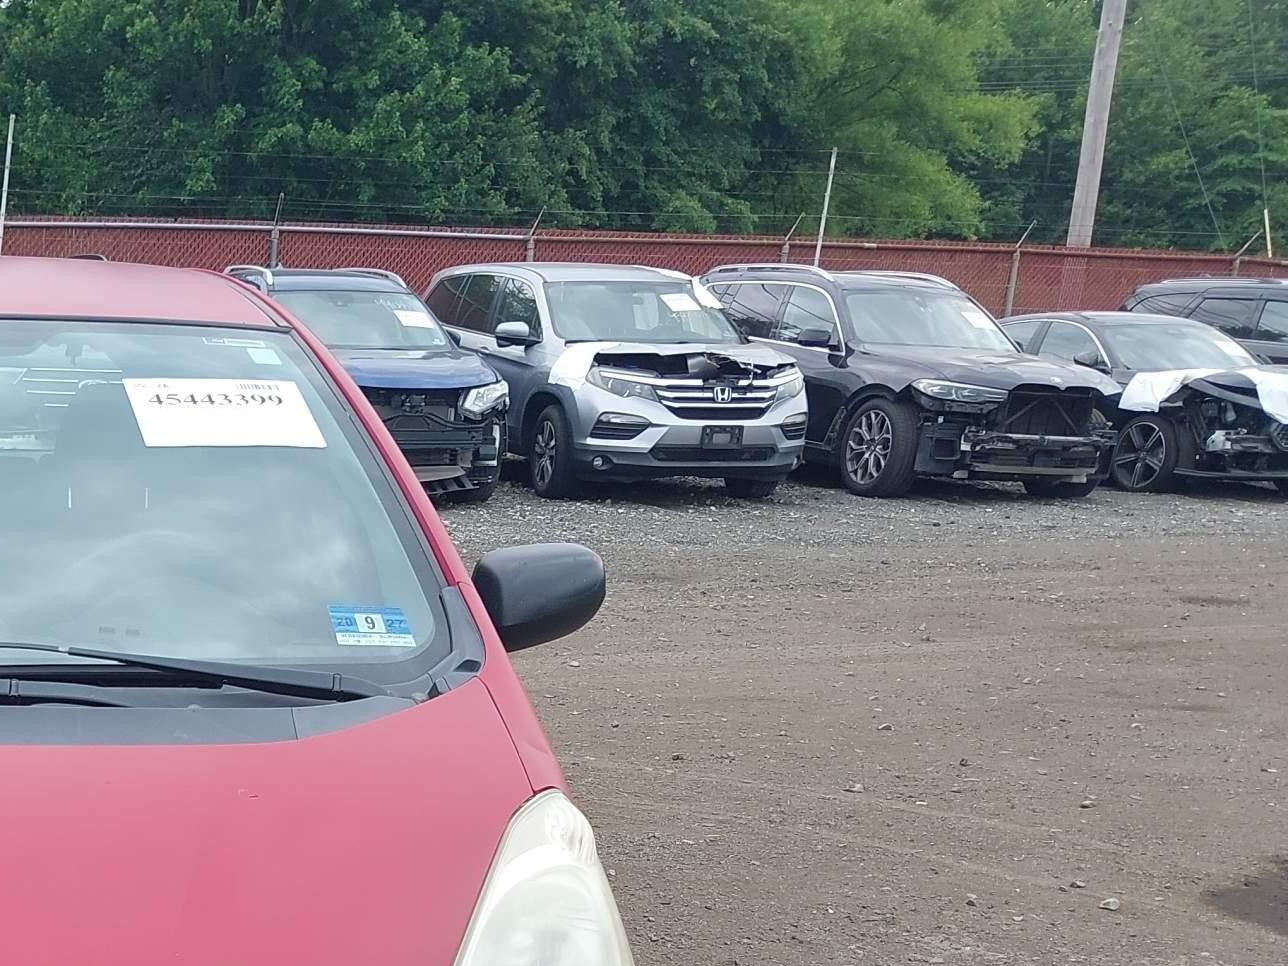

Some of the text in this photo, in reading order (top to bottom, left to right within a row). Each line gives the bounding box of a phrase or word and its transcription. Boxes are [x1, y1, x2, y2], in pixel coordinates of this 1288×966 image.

[148, 392, 284, 407] 45443399
[335, 616, 353, 627] 20
[364, 615, 376, 630] 9
